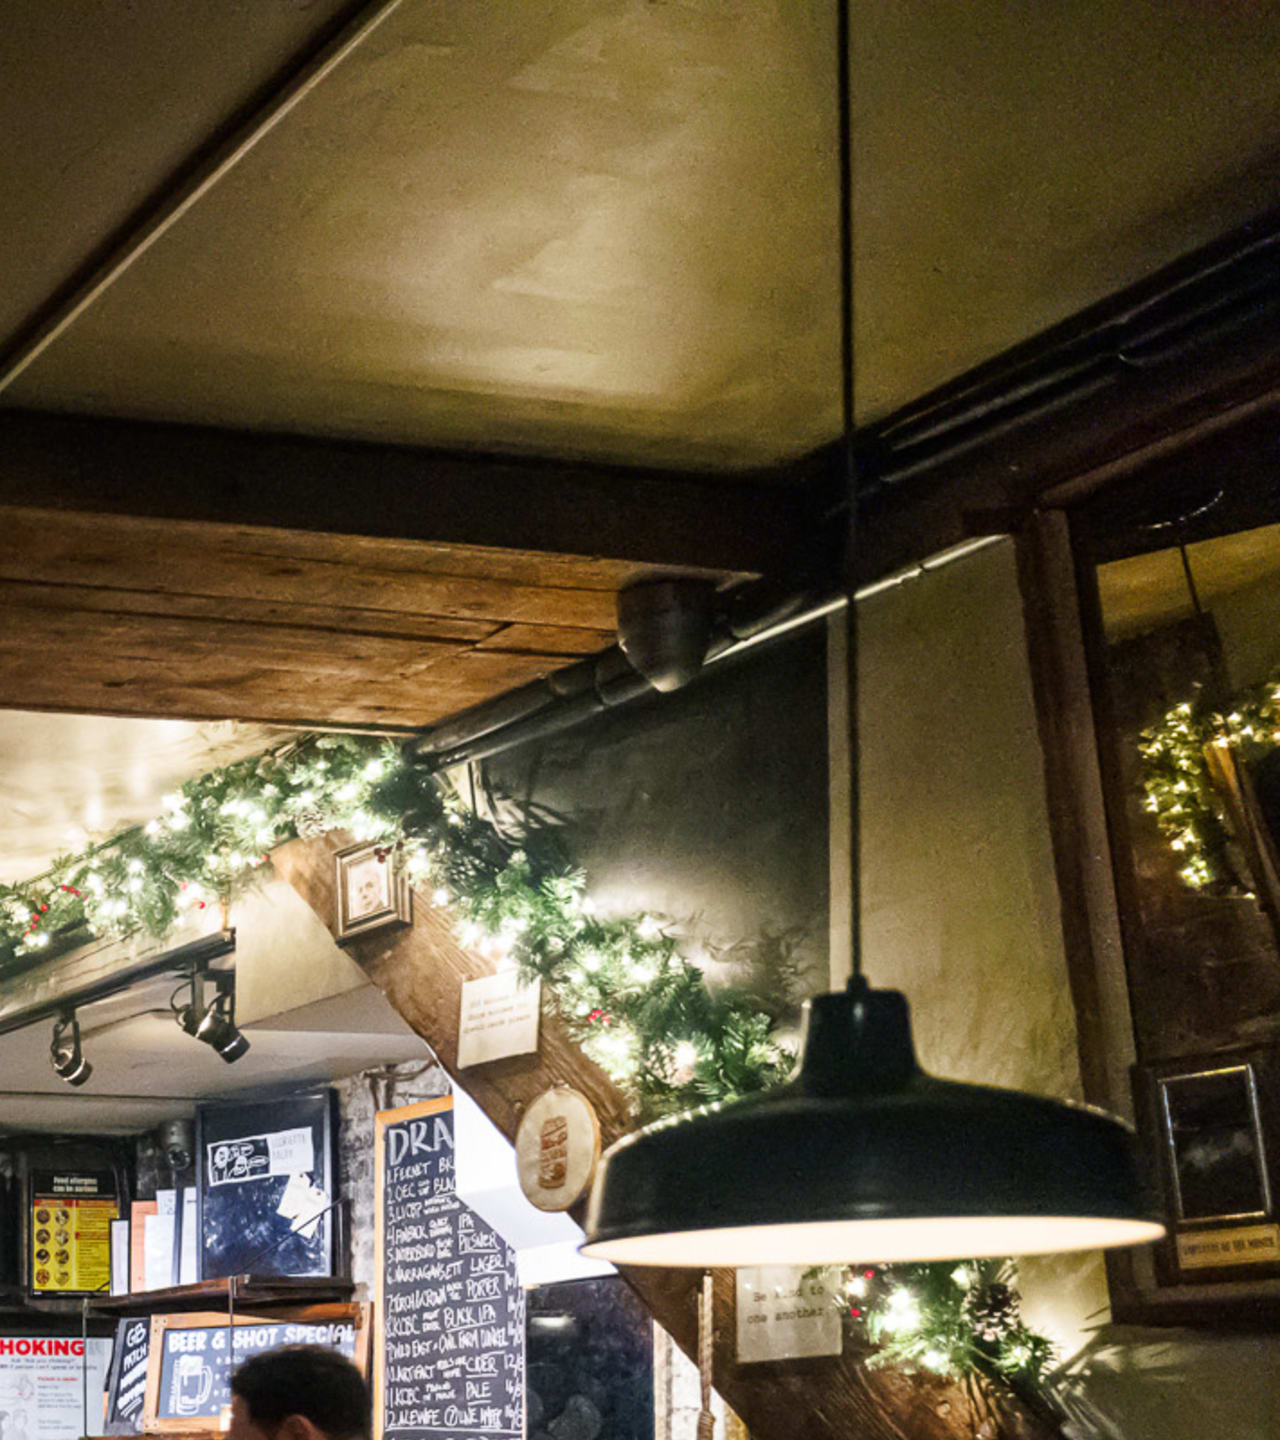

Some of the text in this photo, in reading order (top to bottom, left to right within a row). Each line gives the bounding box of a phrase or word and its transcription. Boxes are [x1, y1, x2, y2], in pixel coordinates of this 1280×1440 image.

[169, 1324, 356, 1353] BEER & SHOT SPECIAL
